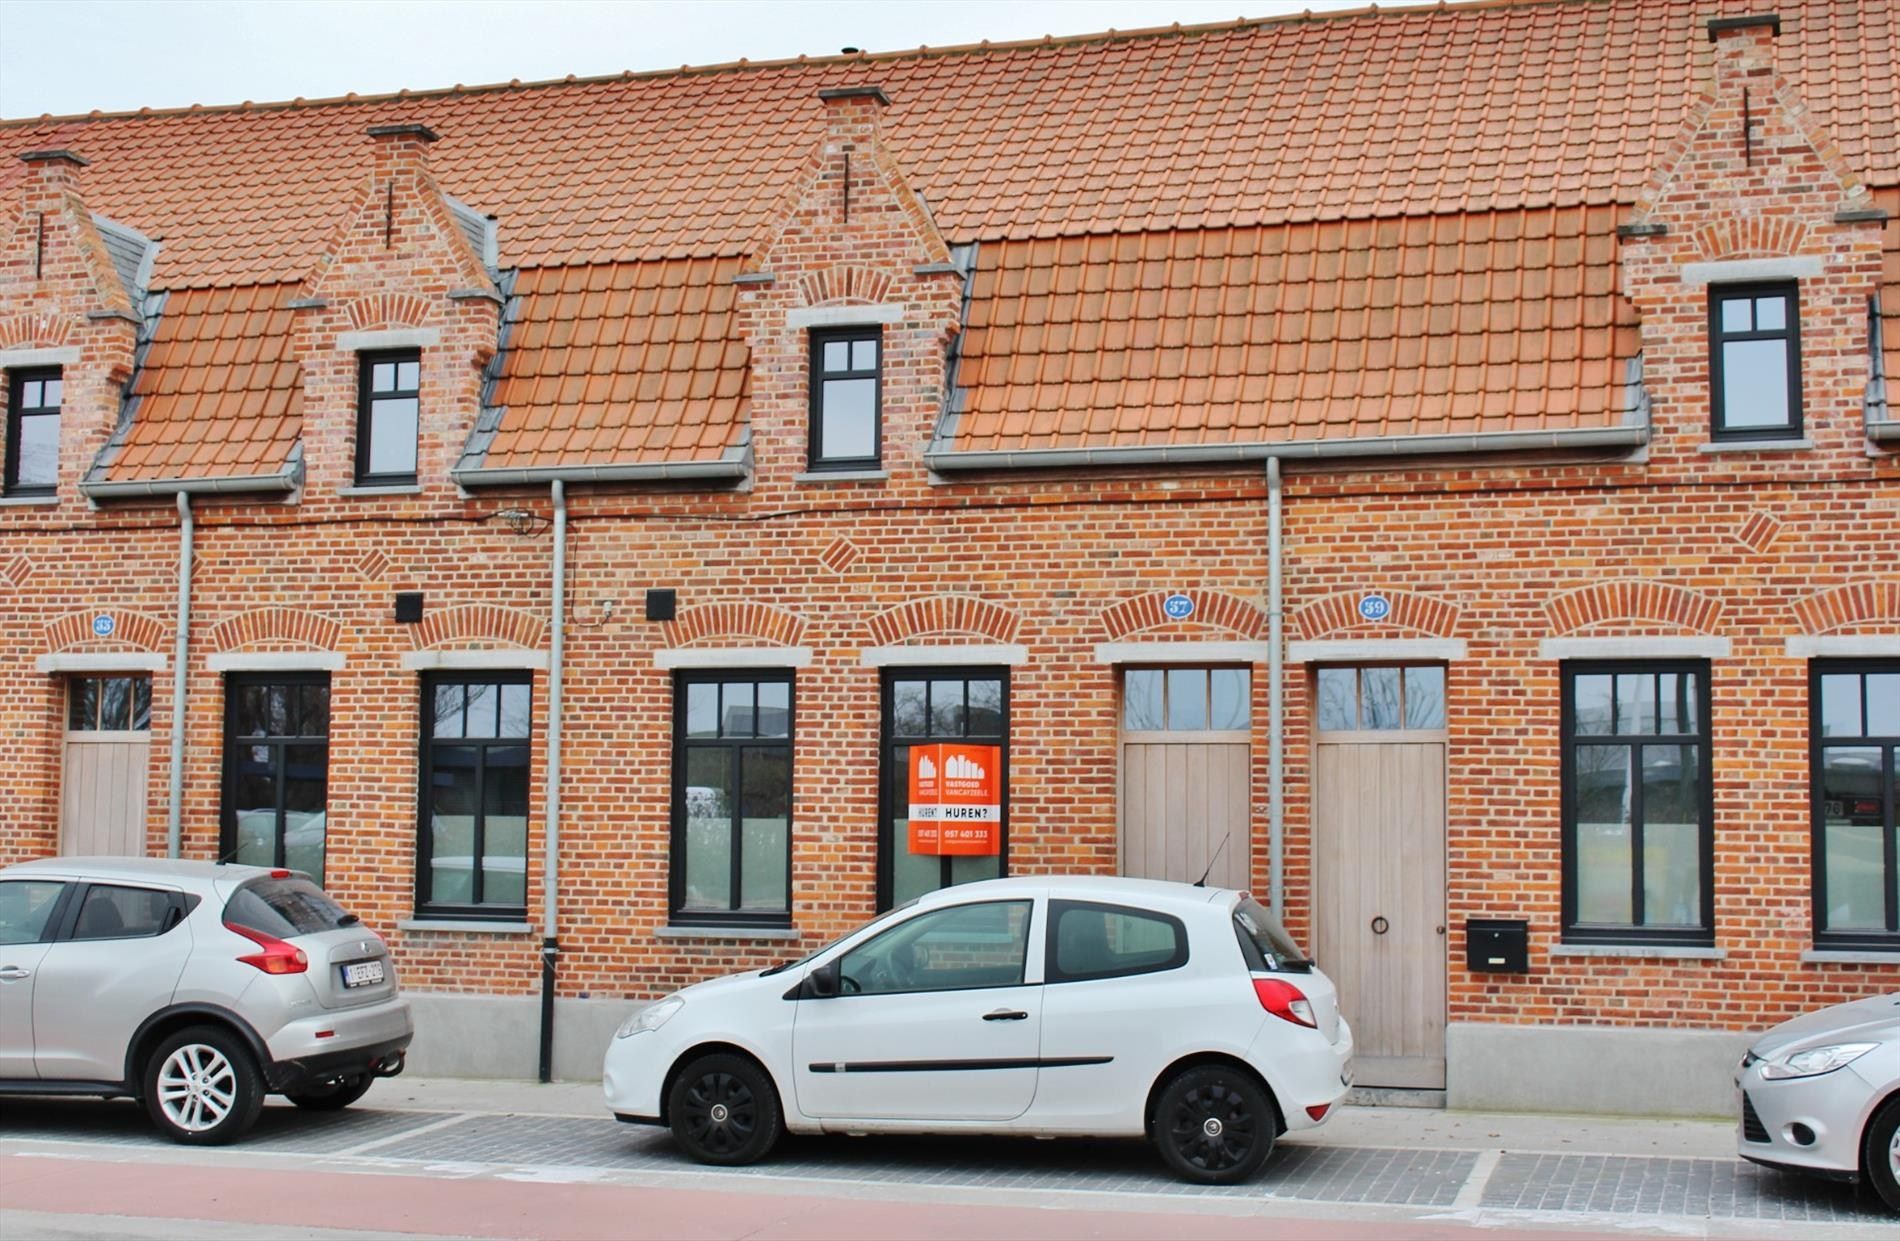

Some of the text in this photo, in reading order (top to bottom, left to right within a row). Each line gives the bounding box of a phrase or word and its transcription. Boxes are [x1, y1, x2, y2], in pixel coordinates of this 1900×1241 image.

[945, 808, 988, 818] HUREN?
[945, 830, 958, 838] 057
[960, 830, 973, 838] 401
